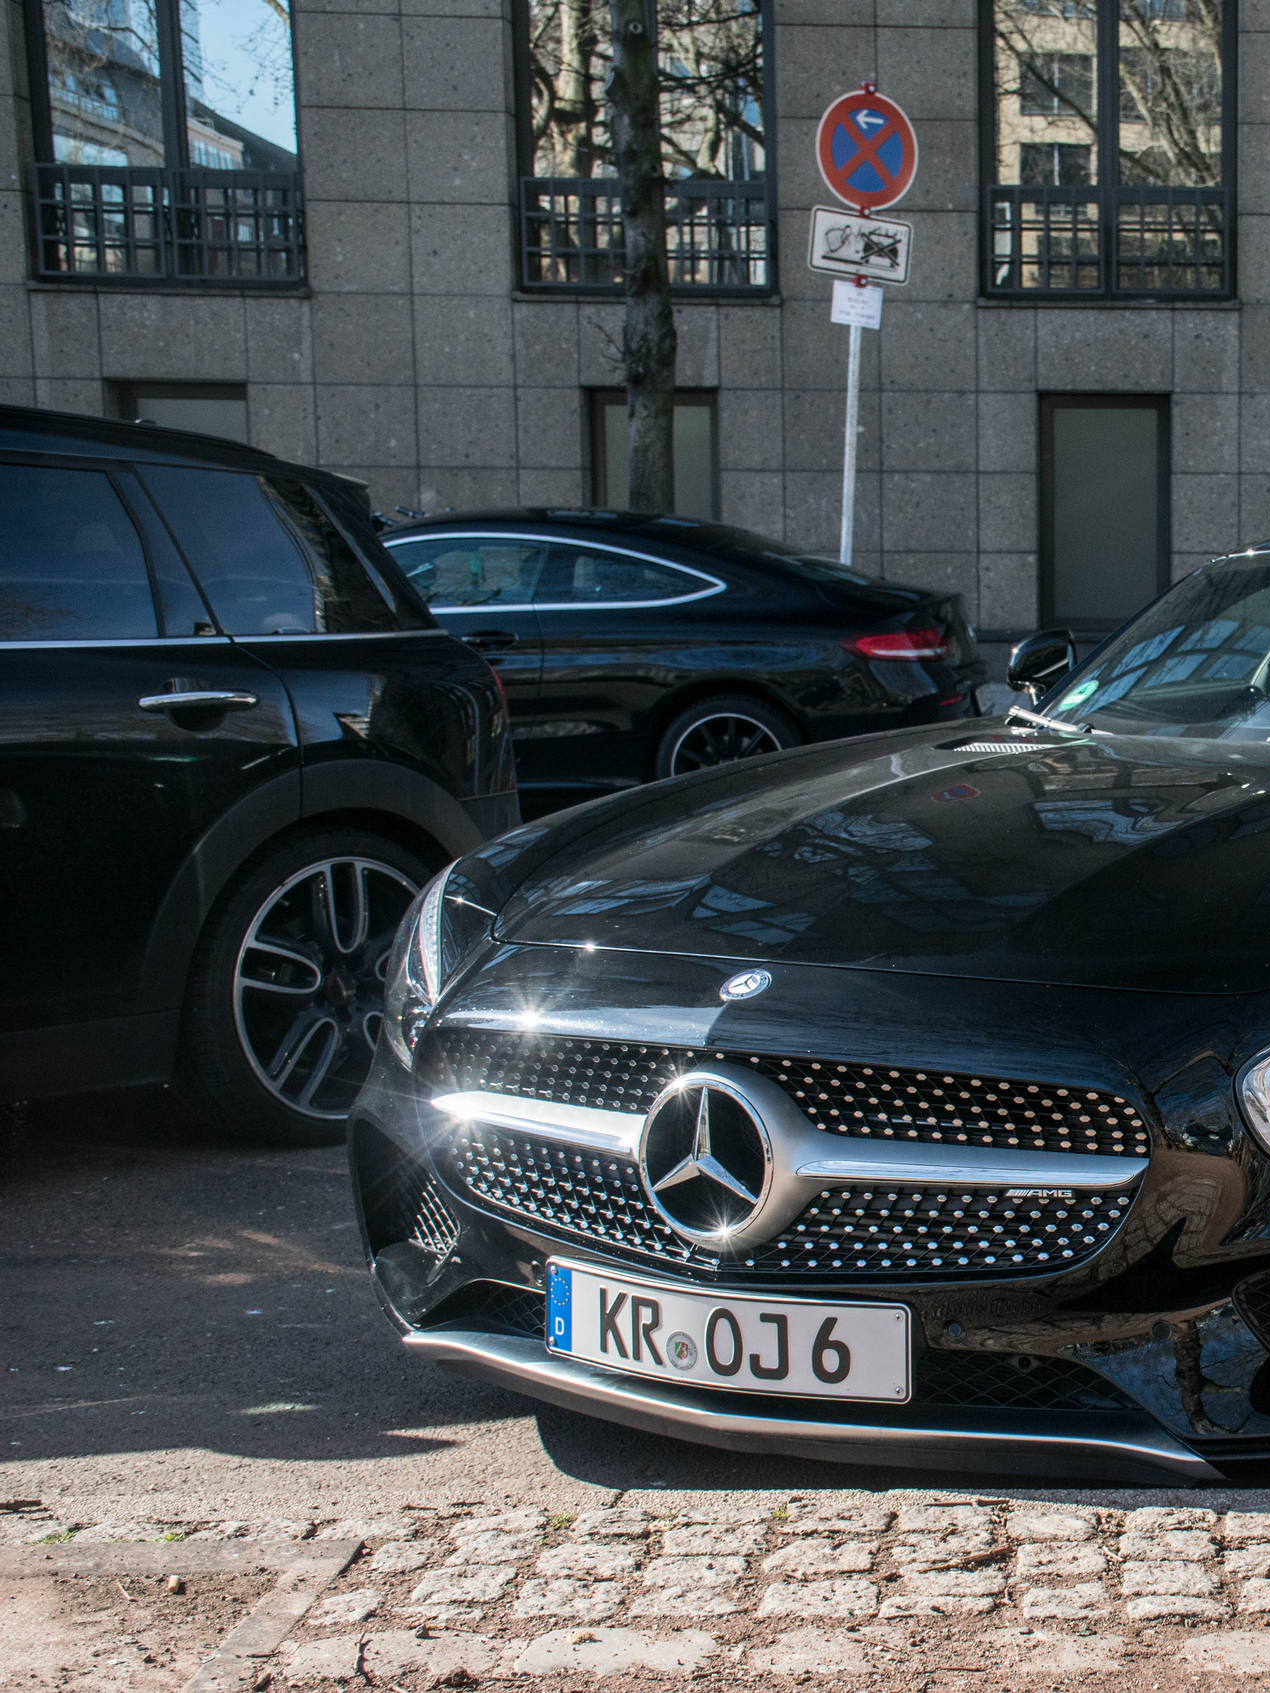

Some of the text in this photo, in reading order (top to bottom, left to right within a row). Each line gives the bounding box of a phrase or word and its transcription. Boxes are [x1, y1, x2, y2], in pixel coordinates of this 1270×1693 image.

[1027, 1188, 1072, 1198] AMG
[554, 1316, 565, 1336] D
[600, 1285, 664, 1367] KR
[705, 1306, 789, 1381] OJ
[811, 1316, 851, 1385] 6
